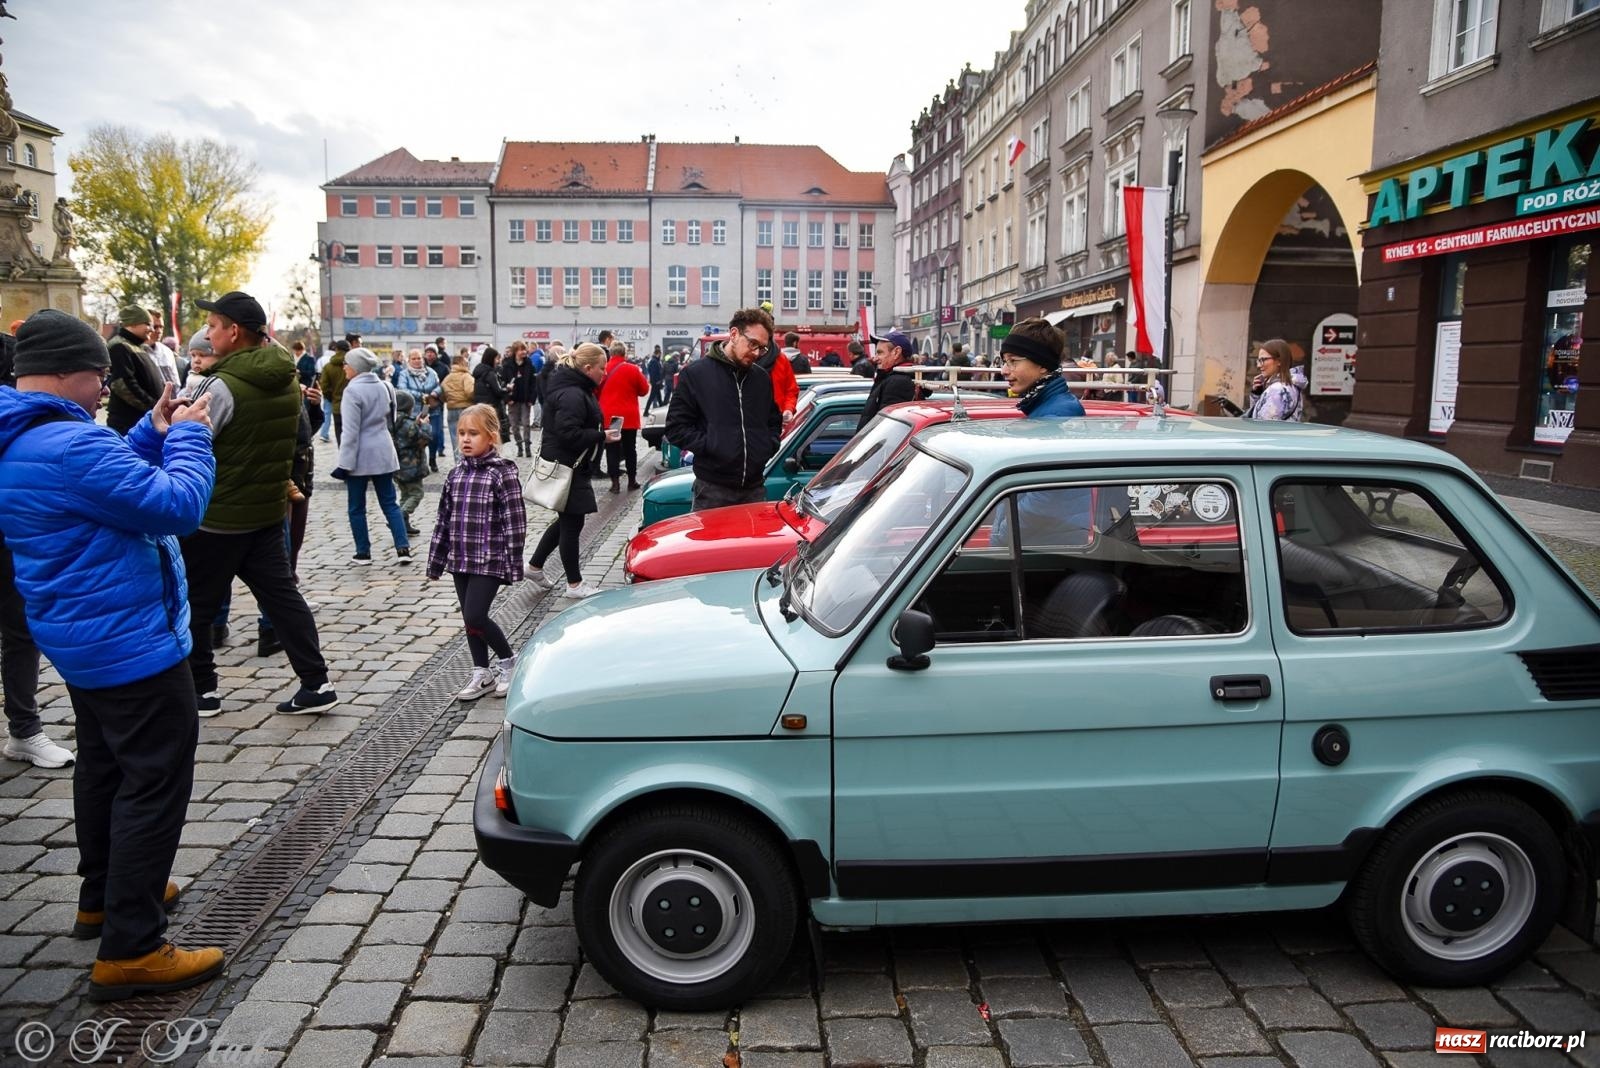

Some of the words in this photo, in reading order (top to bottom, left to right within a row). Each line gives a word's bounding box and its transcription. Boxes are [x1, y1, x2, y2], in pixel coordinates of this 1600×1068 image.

[1369, 117, 1600, 228] APTEK
[1522, 193, 1558, 212] POD
[1385, 244, 1415, 260] RYNEK
[1416, 242, 1428, 254] 12
[1434, 231, 1484, 252] CENTRUM
